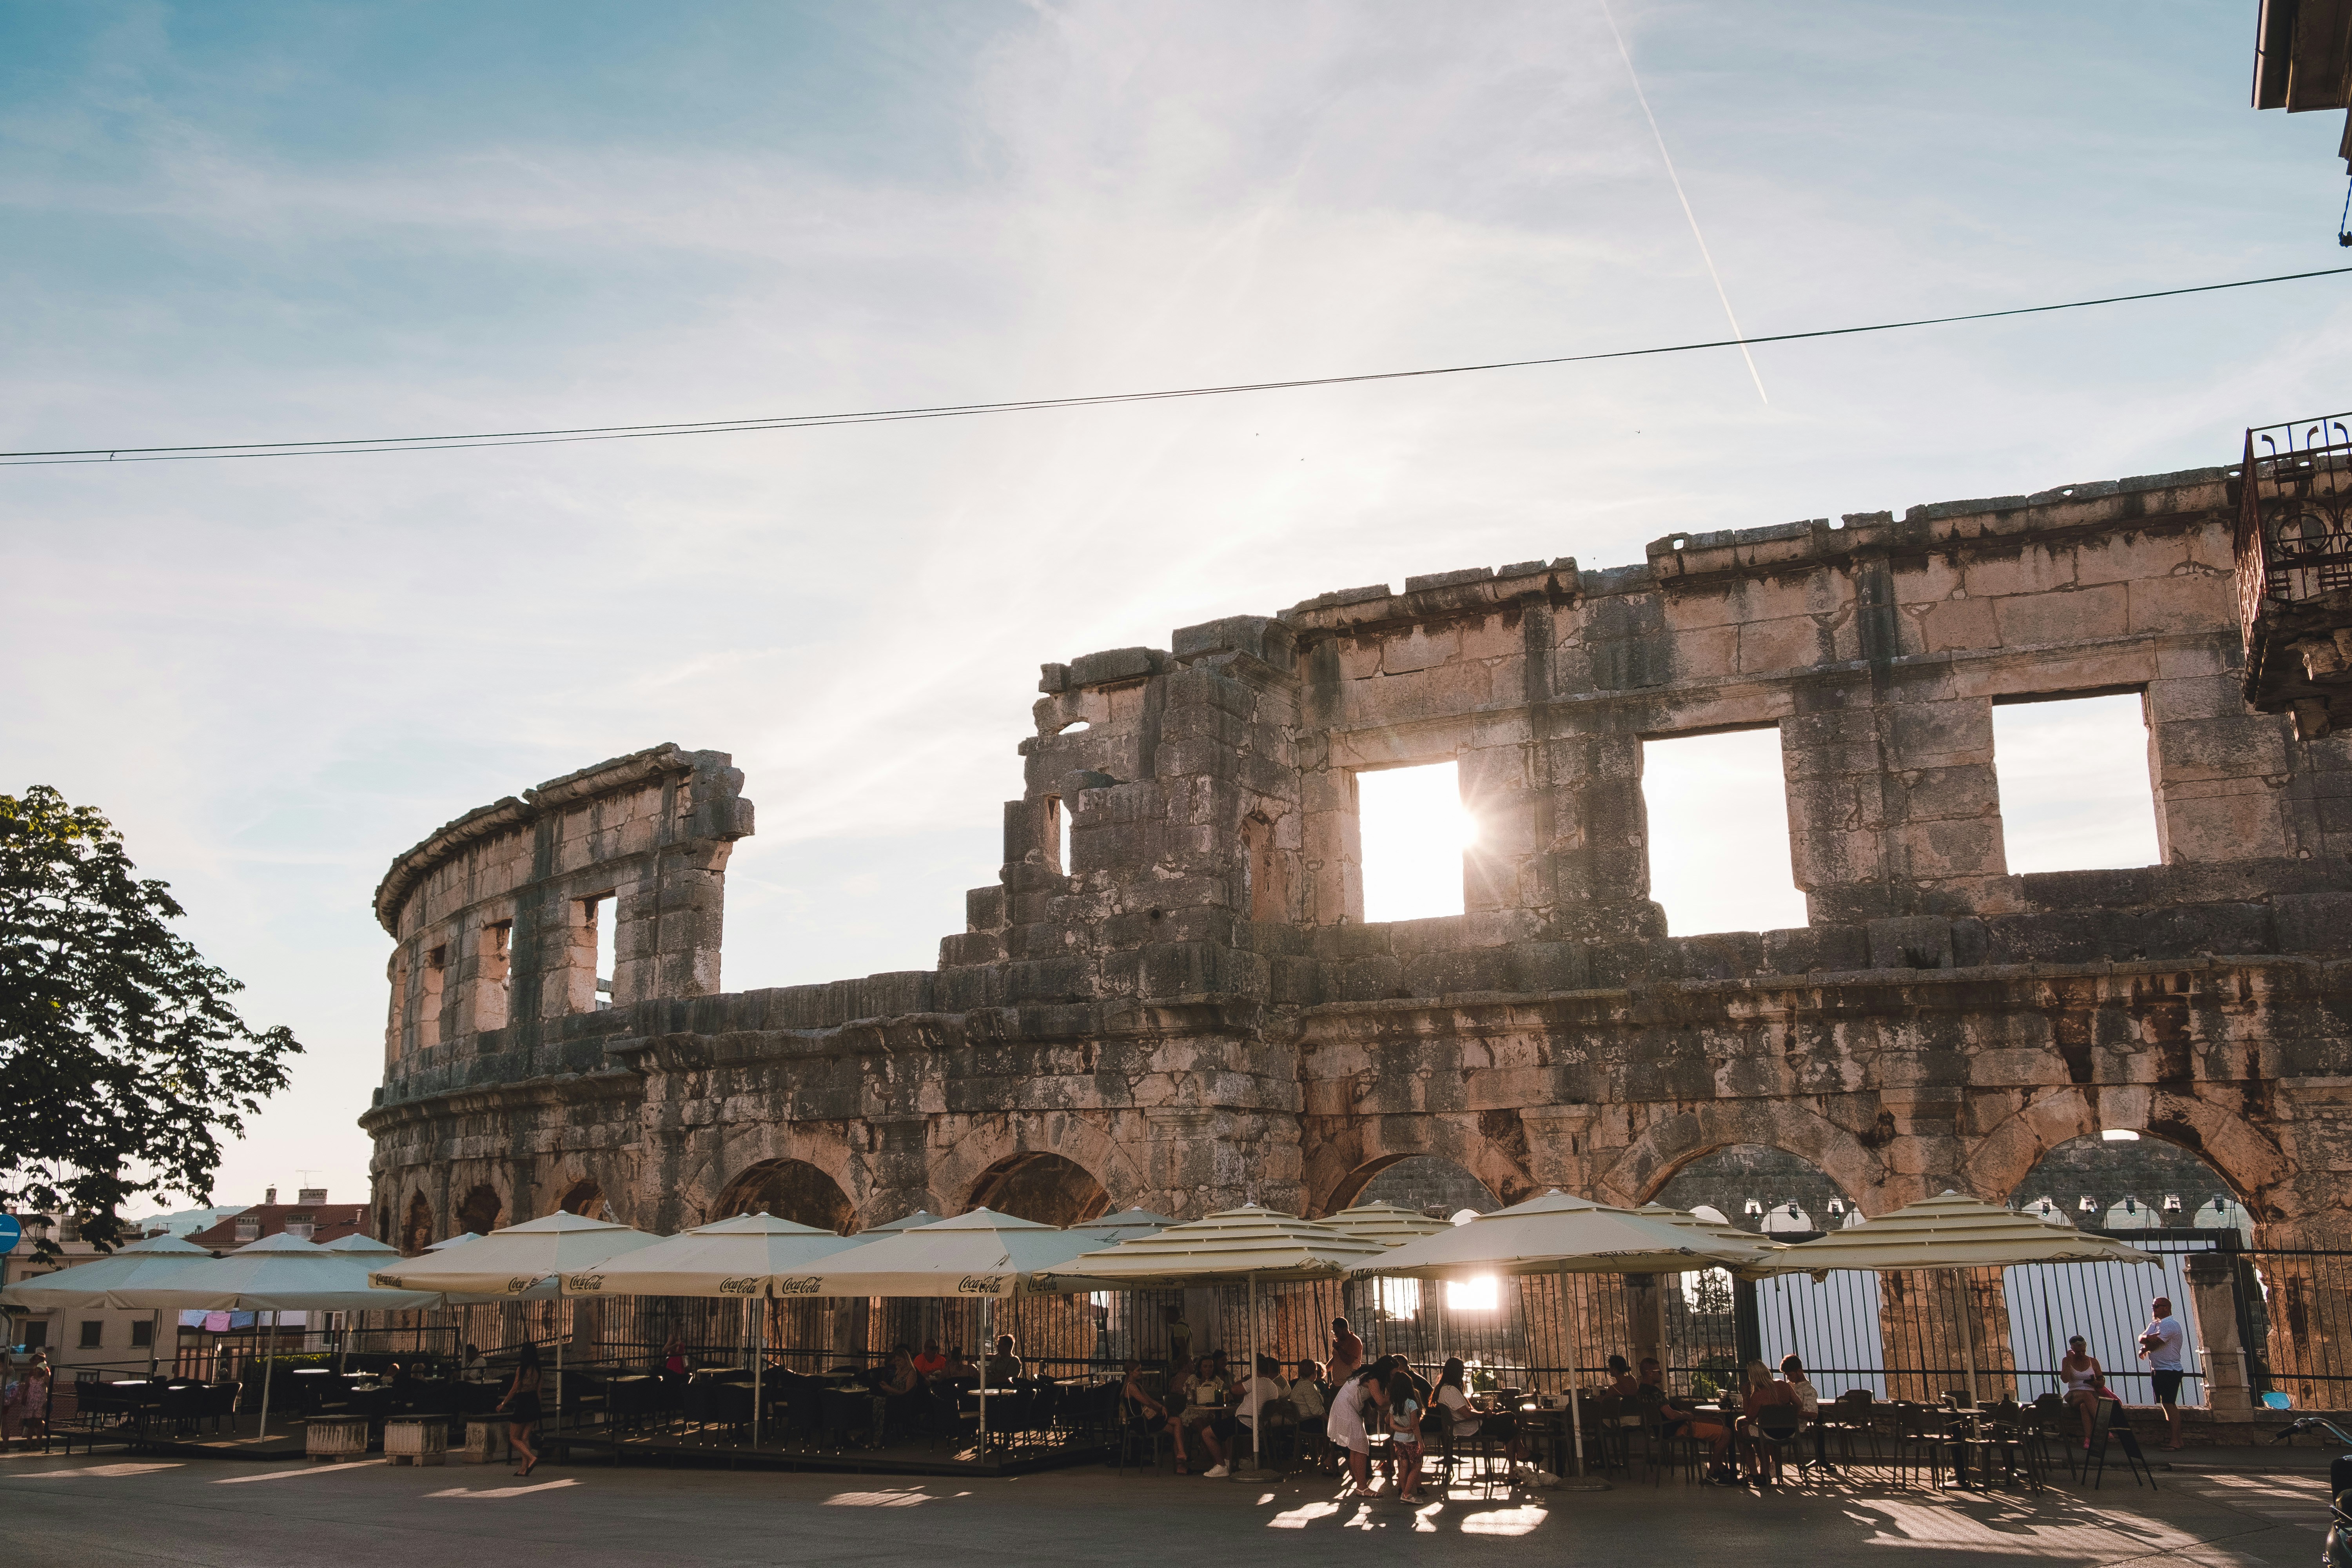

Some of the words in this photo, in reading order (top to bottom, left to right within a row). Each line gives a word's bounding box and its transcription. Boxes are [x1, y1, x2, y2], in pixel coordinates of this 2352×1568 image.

[570, 1275, 606, 1290] Coca-Cola
[720, 1277, 760, 1294] Coca-Cola
[782, 1276, 824, 1294] Coca-Cola
[958, 1275, 1004, 1293] Coca-Cola
